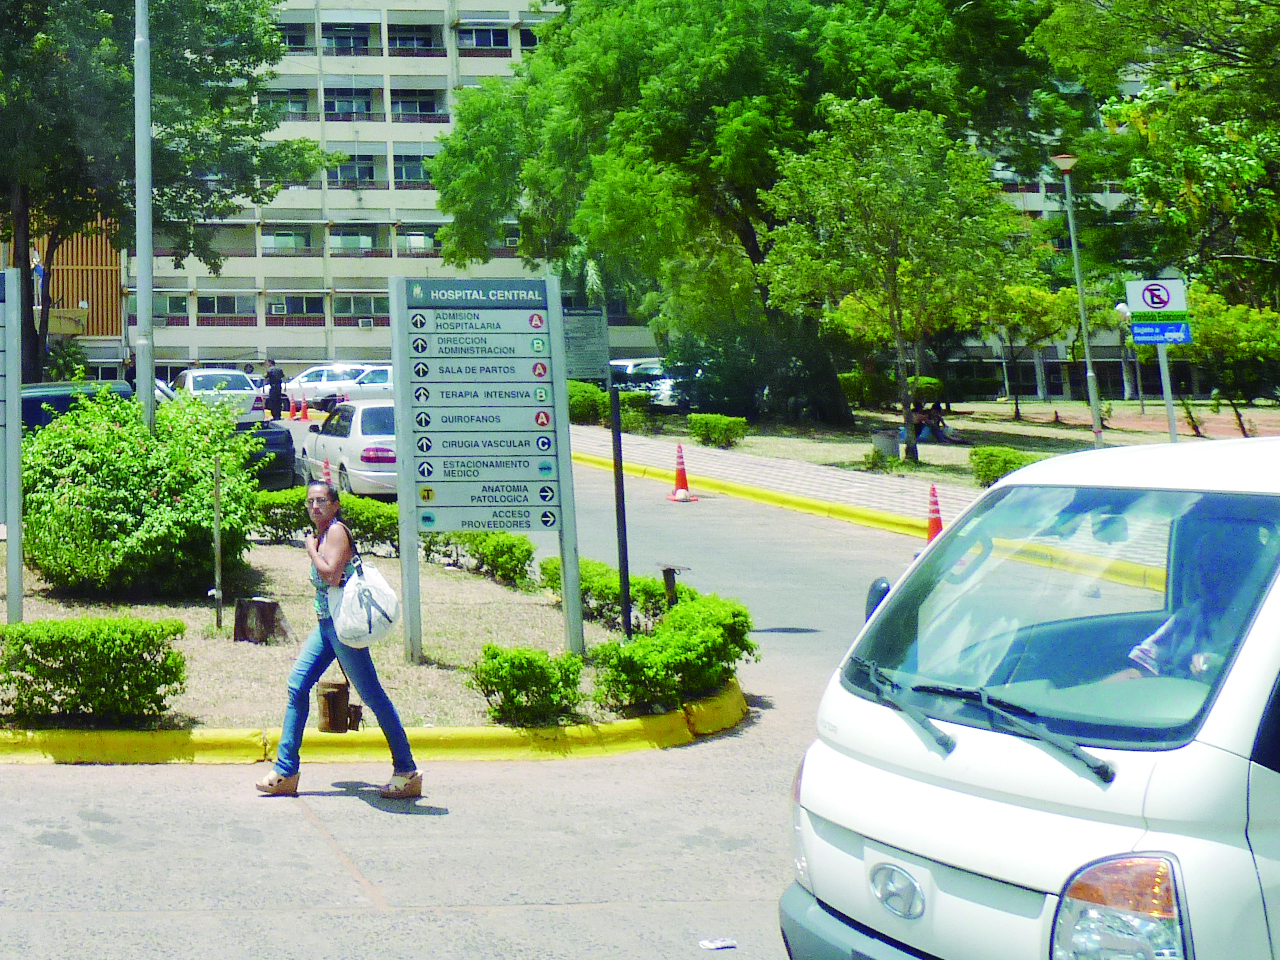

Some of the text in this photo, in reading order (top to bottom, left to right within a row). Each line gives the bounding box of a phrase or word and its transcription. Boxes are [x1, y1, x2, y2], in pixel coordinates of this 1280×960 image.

[430, 289, 542, 300] HOSPITAL CENTRAL
[1149, 289, 1165, 304] E
[435, 312, 480, 320] ADMISION
[532, 315, 541, 326] A
[435, 322, 501, 330] HOSPITALARIA
[437, 336, 487, 345] DIRECCION
[533, 339, 543, 351] B
[438, 346, 515, 354] ADMINISTRACION
[438, 366, 516, 374] SALA DE PARTOS
[534, 364, 544, 375] A
[440, 390, 531, 399] TERAPIA INTENSIVA
[536, 389, 546, 400] B
[441, 415, 501, 424] QUIROFANOS
[537, 412, 548, 424] A
[481, 439, 531, 449] VASCULAR
[538, 437, 549, 450] C
[443, 460, 530, 469] ESTACIONAMIENTO
[481, 485, 529, 493] ANATOMIA
[492, 510, 531, 518] ACCESO
[461, 520, 531, 529] PROVEEDORES
